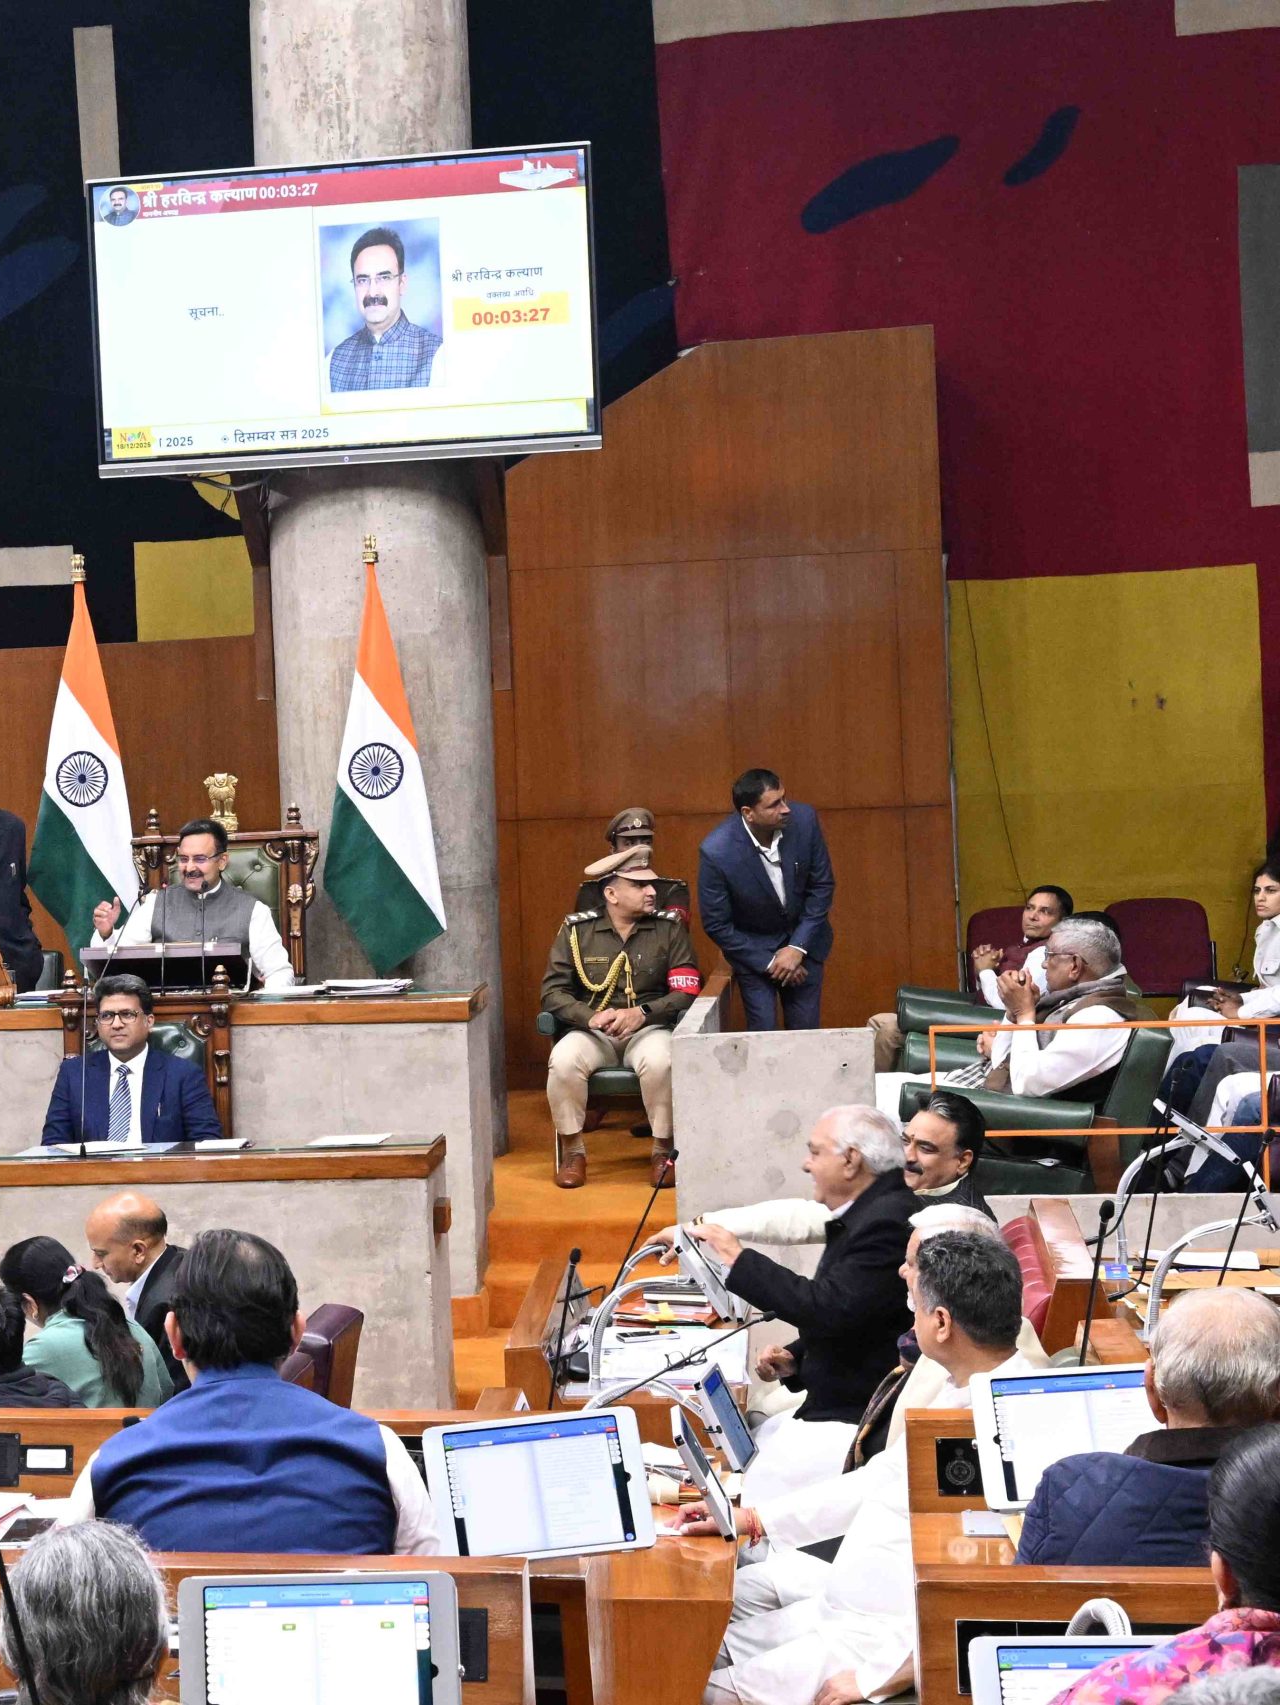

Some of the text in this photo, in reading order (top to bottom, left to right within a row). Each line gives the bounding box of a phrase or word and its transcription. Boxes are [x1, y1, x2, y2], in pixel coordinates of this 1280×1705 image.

[143, 183, 318, 208] श्री हरविन्द्र कल्याण 00:03:27
[452, 269, 462, 282] श्री
[506, 267, 543, 277] कल्याण
[472, 308, 550, 326] 00:03:27
[166, 436, 194, 447] 2025
[279, 430, 297, 440] सत्र
[301, 428, 329, 439] 2025
